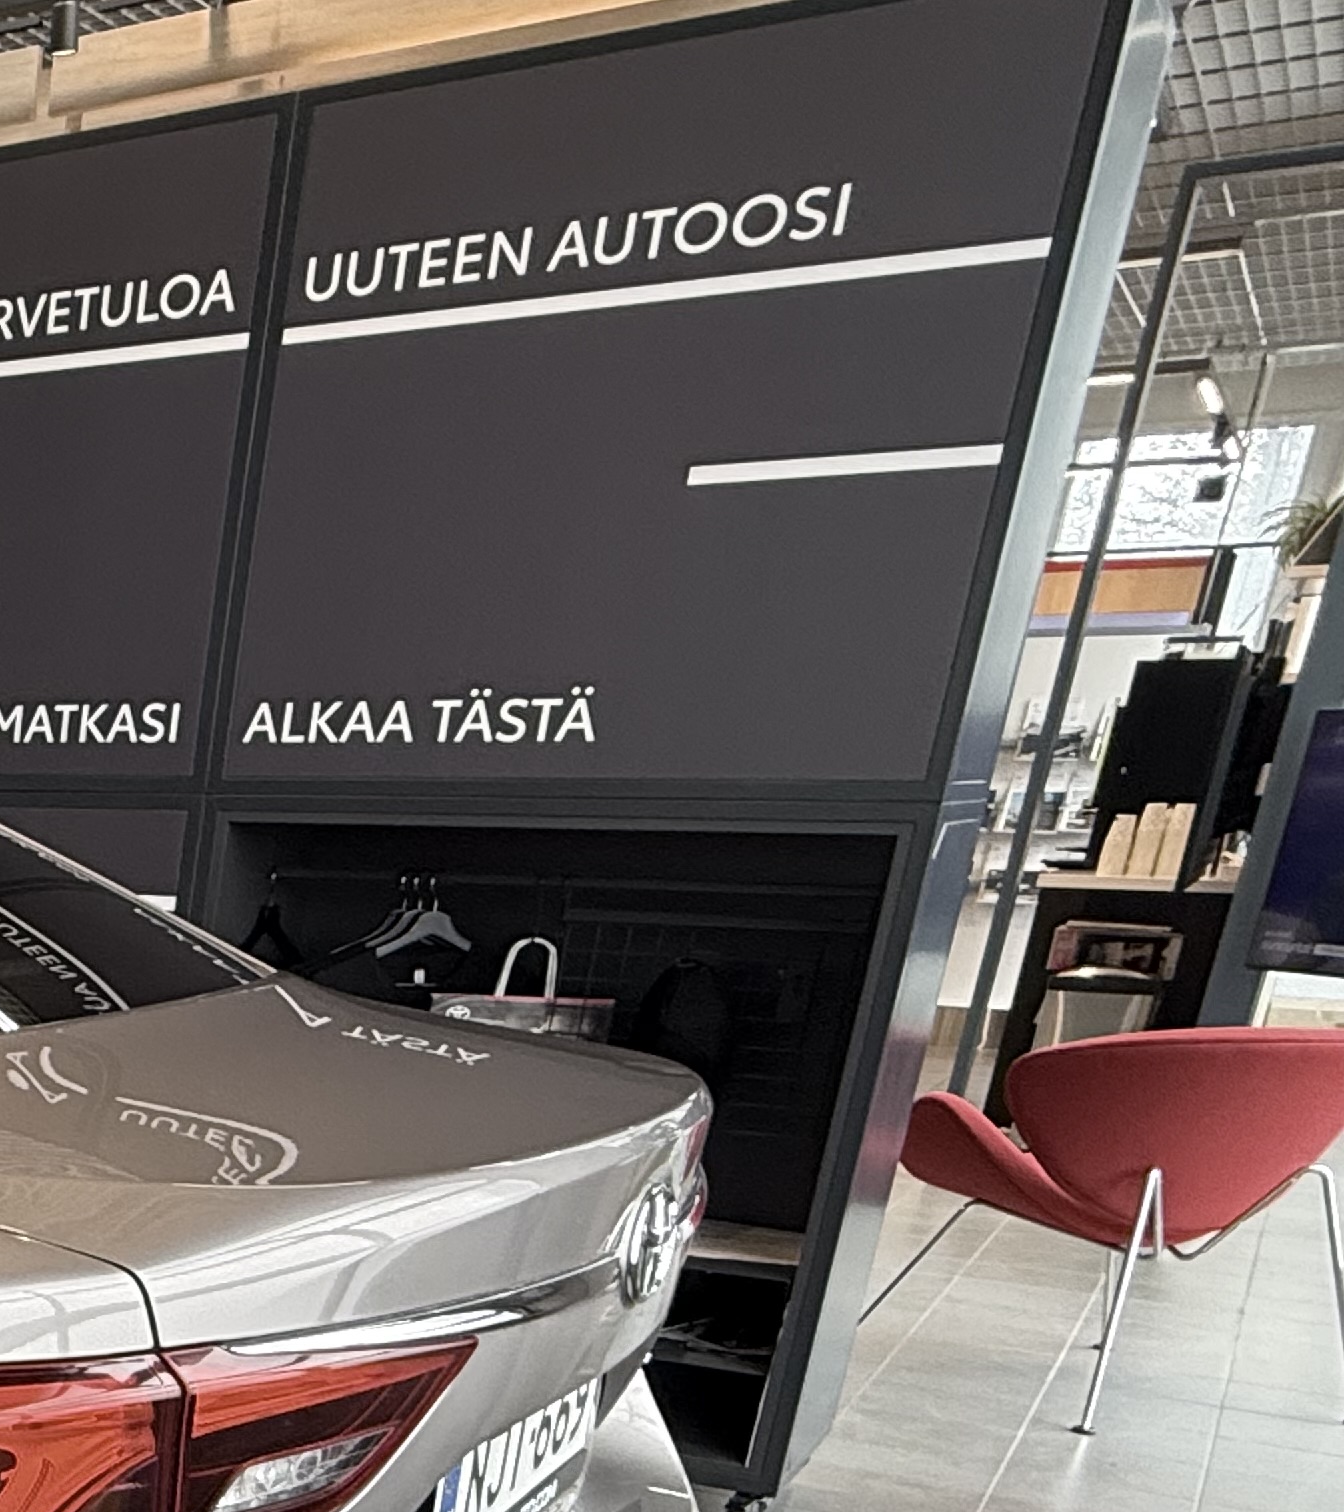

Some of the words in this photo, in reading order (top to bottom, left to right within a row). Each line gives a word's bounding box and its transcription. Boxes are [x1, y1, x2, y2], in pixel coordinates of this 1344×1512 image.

[304, 227, 534, 303] UUTEEN
[545, 182, 853, 273] AUTOOSI
[241, 700, 414, 744] ALKAA
[431, 685, 596, 744] TÄSTÄ
